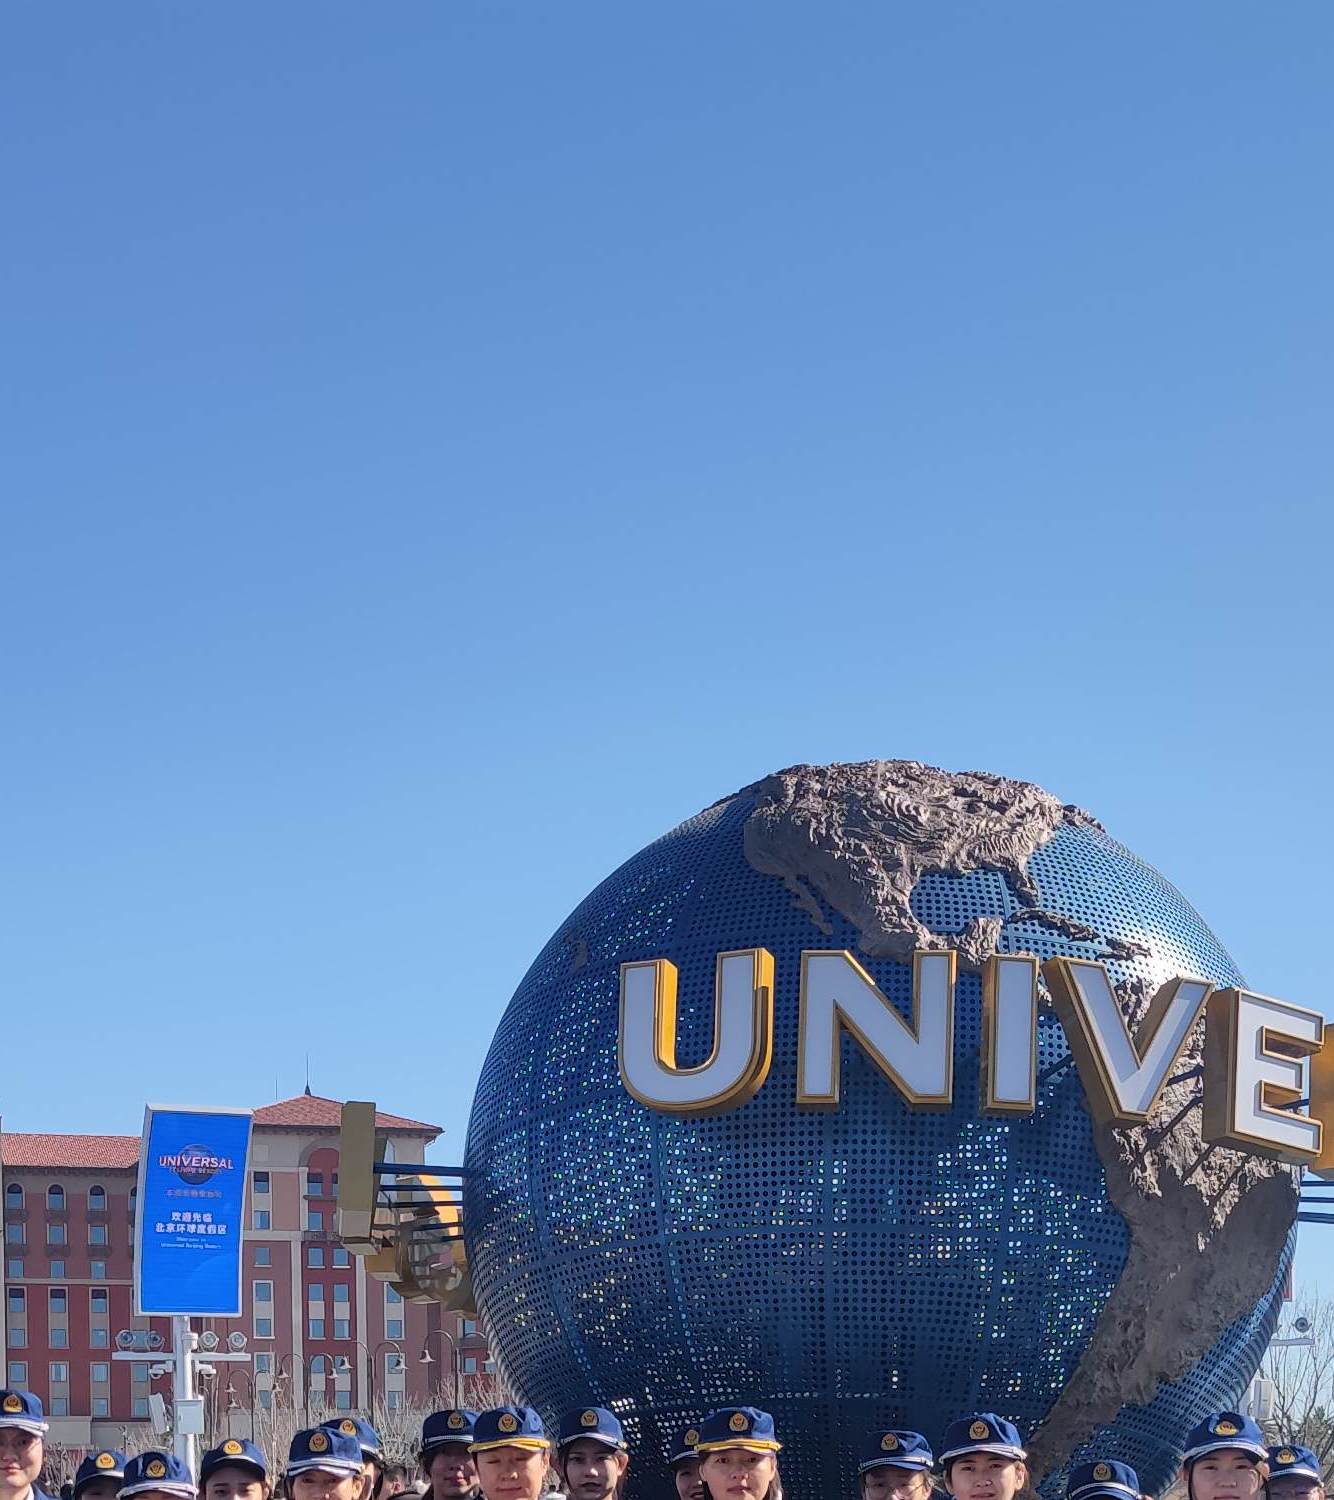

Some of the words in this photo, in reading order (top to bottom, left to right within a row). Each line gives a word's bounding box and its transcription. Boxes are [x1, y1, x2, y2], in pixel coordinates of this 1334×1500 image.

[159, 1154, 234, 1169] UNIVERSAL
[171, 1211, 212, 1222] 欢迎光临
[155, 1222, 227, 1235] 北京环球度假区
